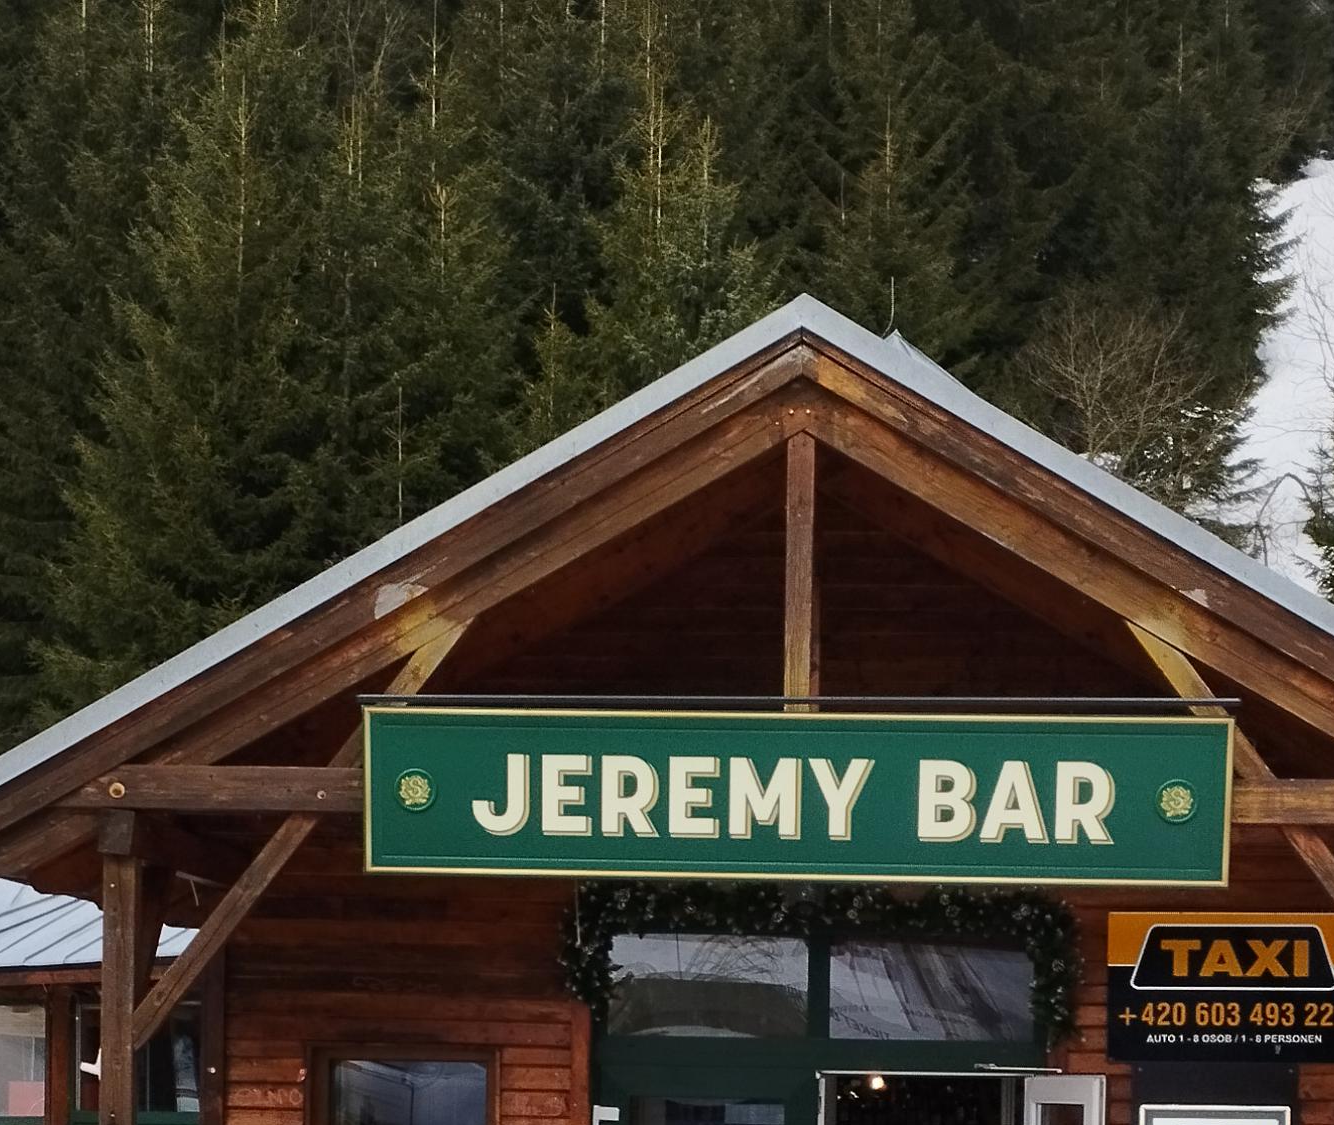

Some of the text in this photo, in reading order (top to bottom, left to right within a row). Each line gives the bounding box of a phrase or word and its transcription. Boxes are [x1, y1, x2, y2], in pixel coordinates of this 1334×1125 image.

[472, 753, 1116, 846] JEREMY BAR
[1160, 939, 1310, 978] TAXI
[1118, 1002, 1187, 1027] +420
[1195, 1002, 1241, 1027] 603
[1249, 1002, 1296, 1027] 493
[1146, 1034, 1176, 1043] AUTO
[1202, 1034, 1233, 1043] OSOB
[1264, 1034, 1322, 1044] PERSONEN
